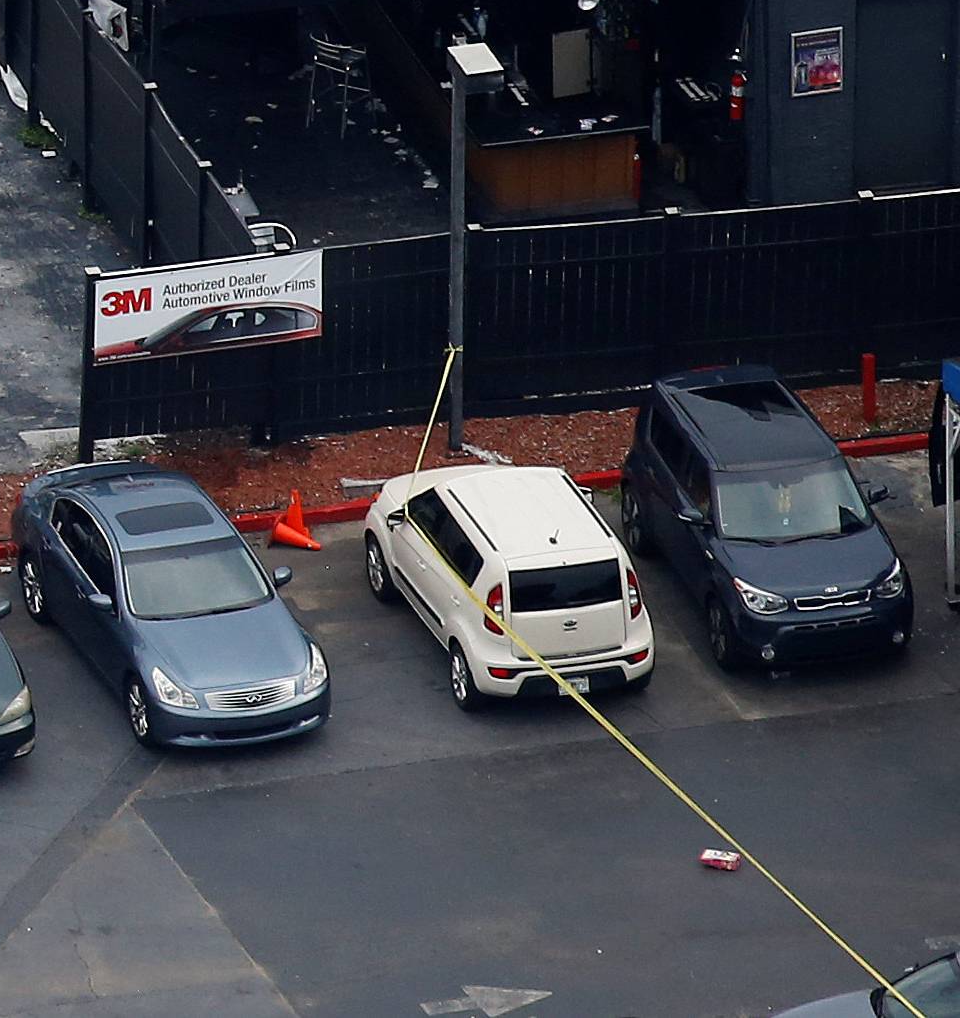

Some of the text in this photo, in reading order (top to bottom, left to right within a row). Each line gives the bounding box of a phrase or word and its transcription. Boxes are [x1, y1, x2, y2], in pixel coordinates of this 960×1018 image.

[162, 273, 267, 296] Authorized Dealer
[162, 278, 316, 310] Automotive Window Films
[100, 287, 152, 317] 3M
